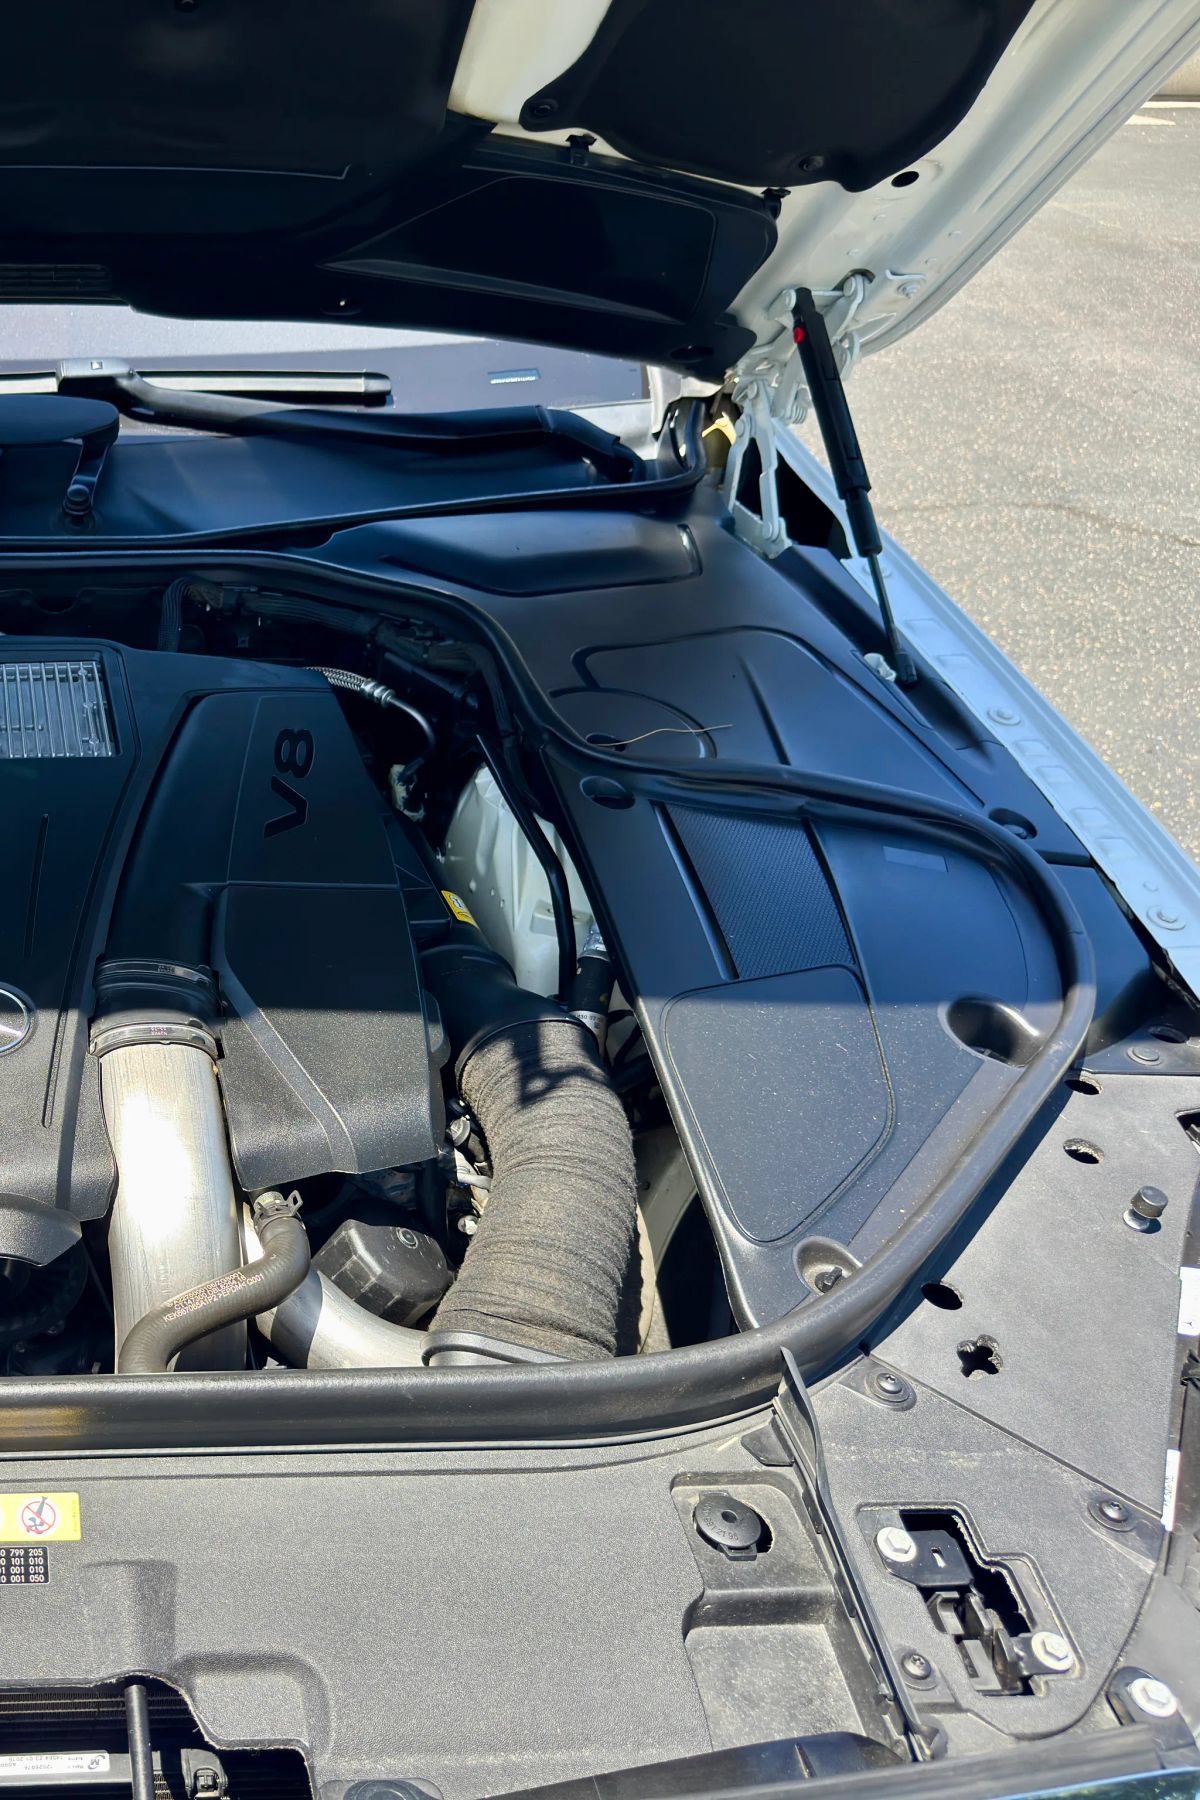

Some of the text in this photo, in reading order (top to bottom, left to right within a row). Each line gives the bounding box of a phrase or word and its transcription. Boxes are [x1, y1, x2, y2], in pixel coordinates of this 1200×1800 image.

[263, 729, 316, 839] V8
[9, 1549, 24, 1557] 799
[28, 1548, 43, 1556] 205
[11, 1557, 24, 1565] 101
[28, 1557, 44, 1565] 010
[10, 1566, 24, 1574] 001
[29, 1566, 44, 1574] 010
[10, 1575, 24, 1583] 001
[29, 1574, 44, 1582] 050
